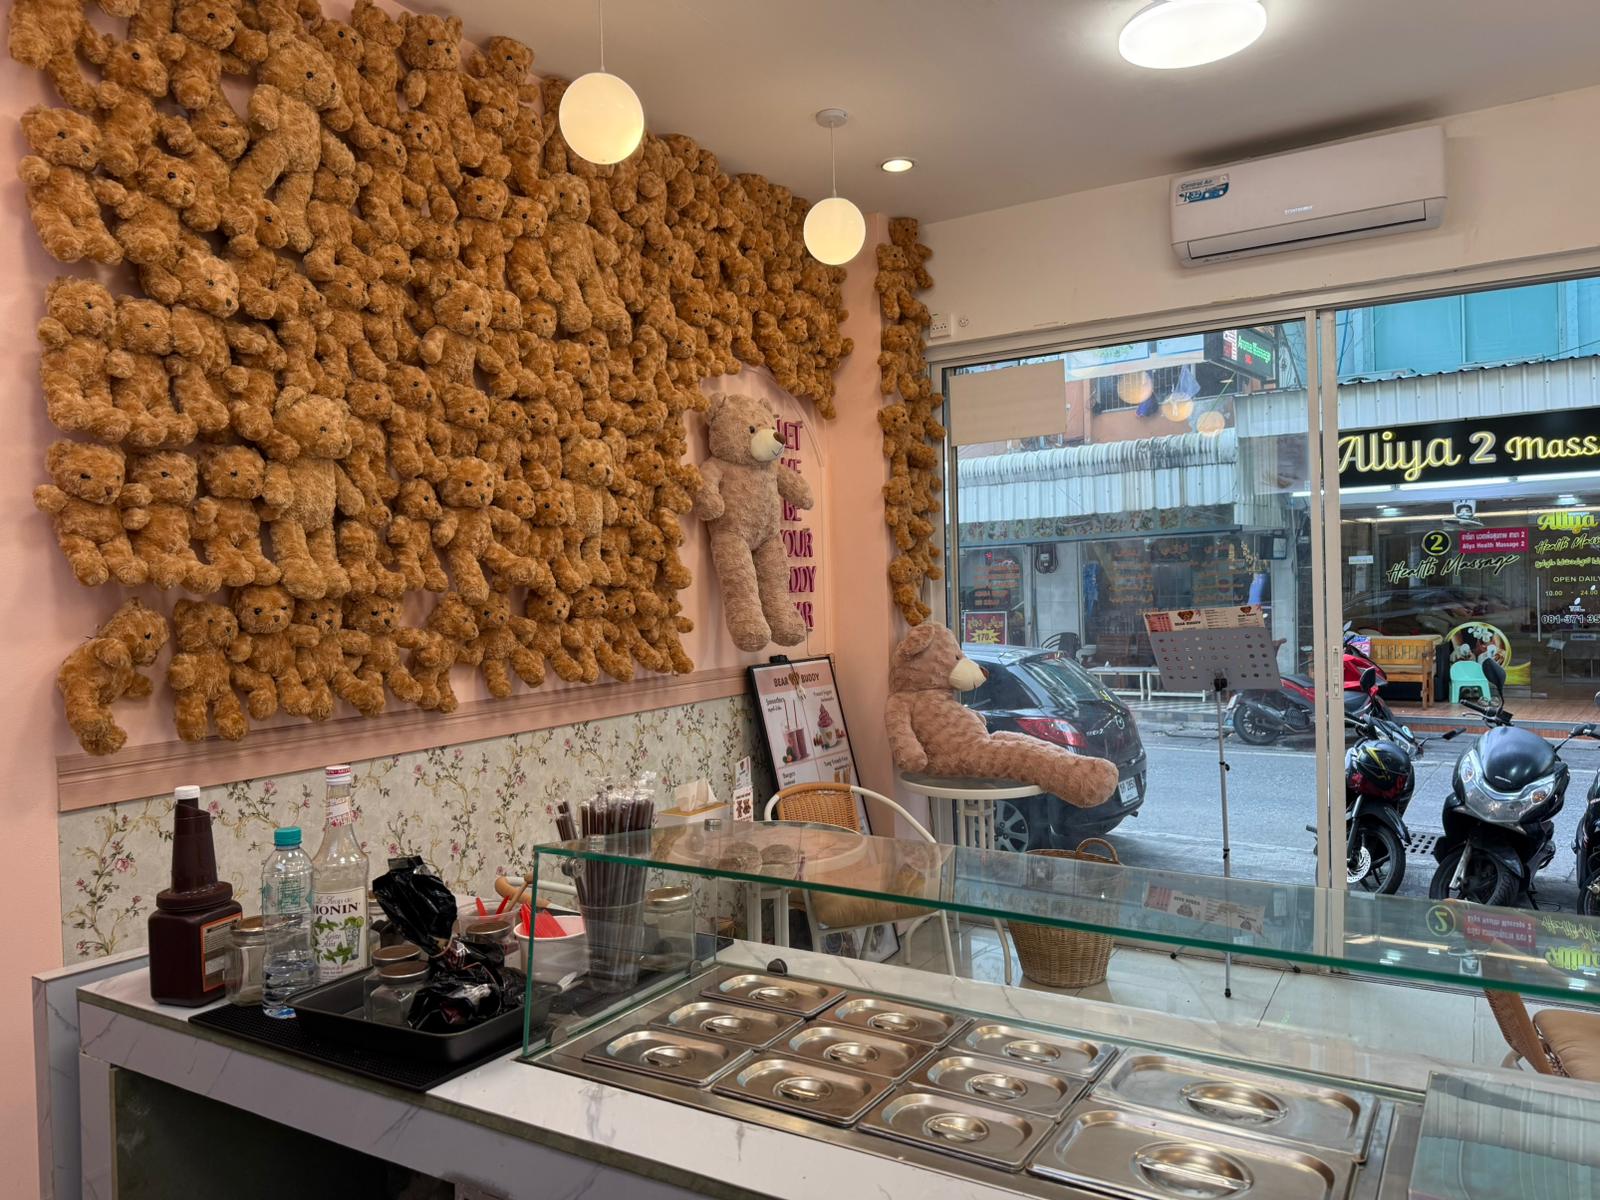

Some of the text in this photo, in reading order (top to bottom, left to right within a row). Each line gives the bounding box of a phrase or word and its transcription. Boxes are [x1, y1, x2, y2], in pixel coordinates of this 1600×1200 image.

[1338, 431, 1461, 482] Aliya
[1468, 431, 1497, 464] 2
[1430, 534, 1444, 551] 2
[789, 565, 816, 593] DDY
[1386, 553, 1520, 584] Health Massage
[773, 672, 819, 687] BEAR BUDDY
